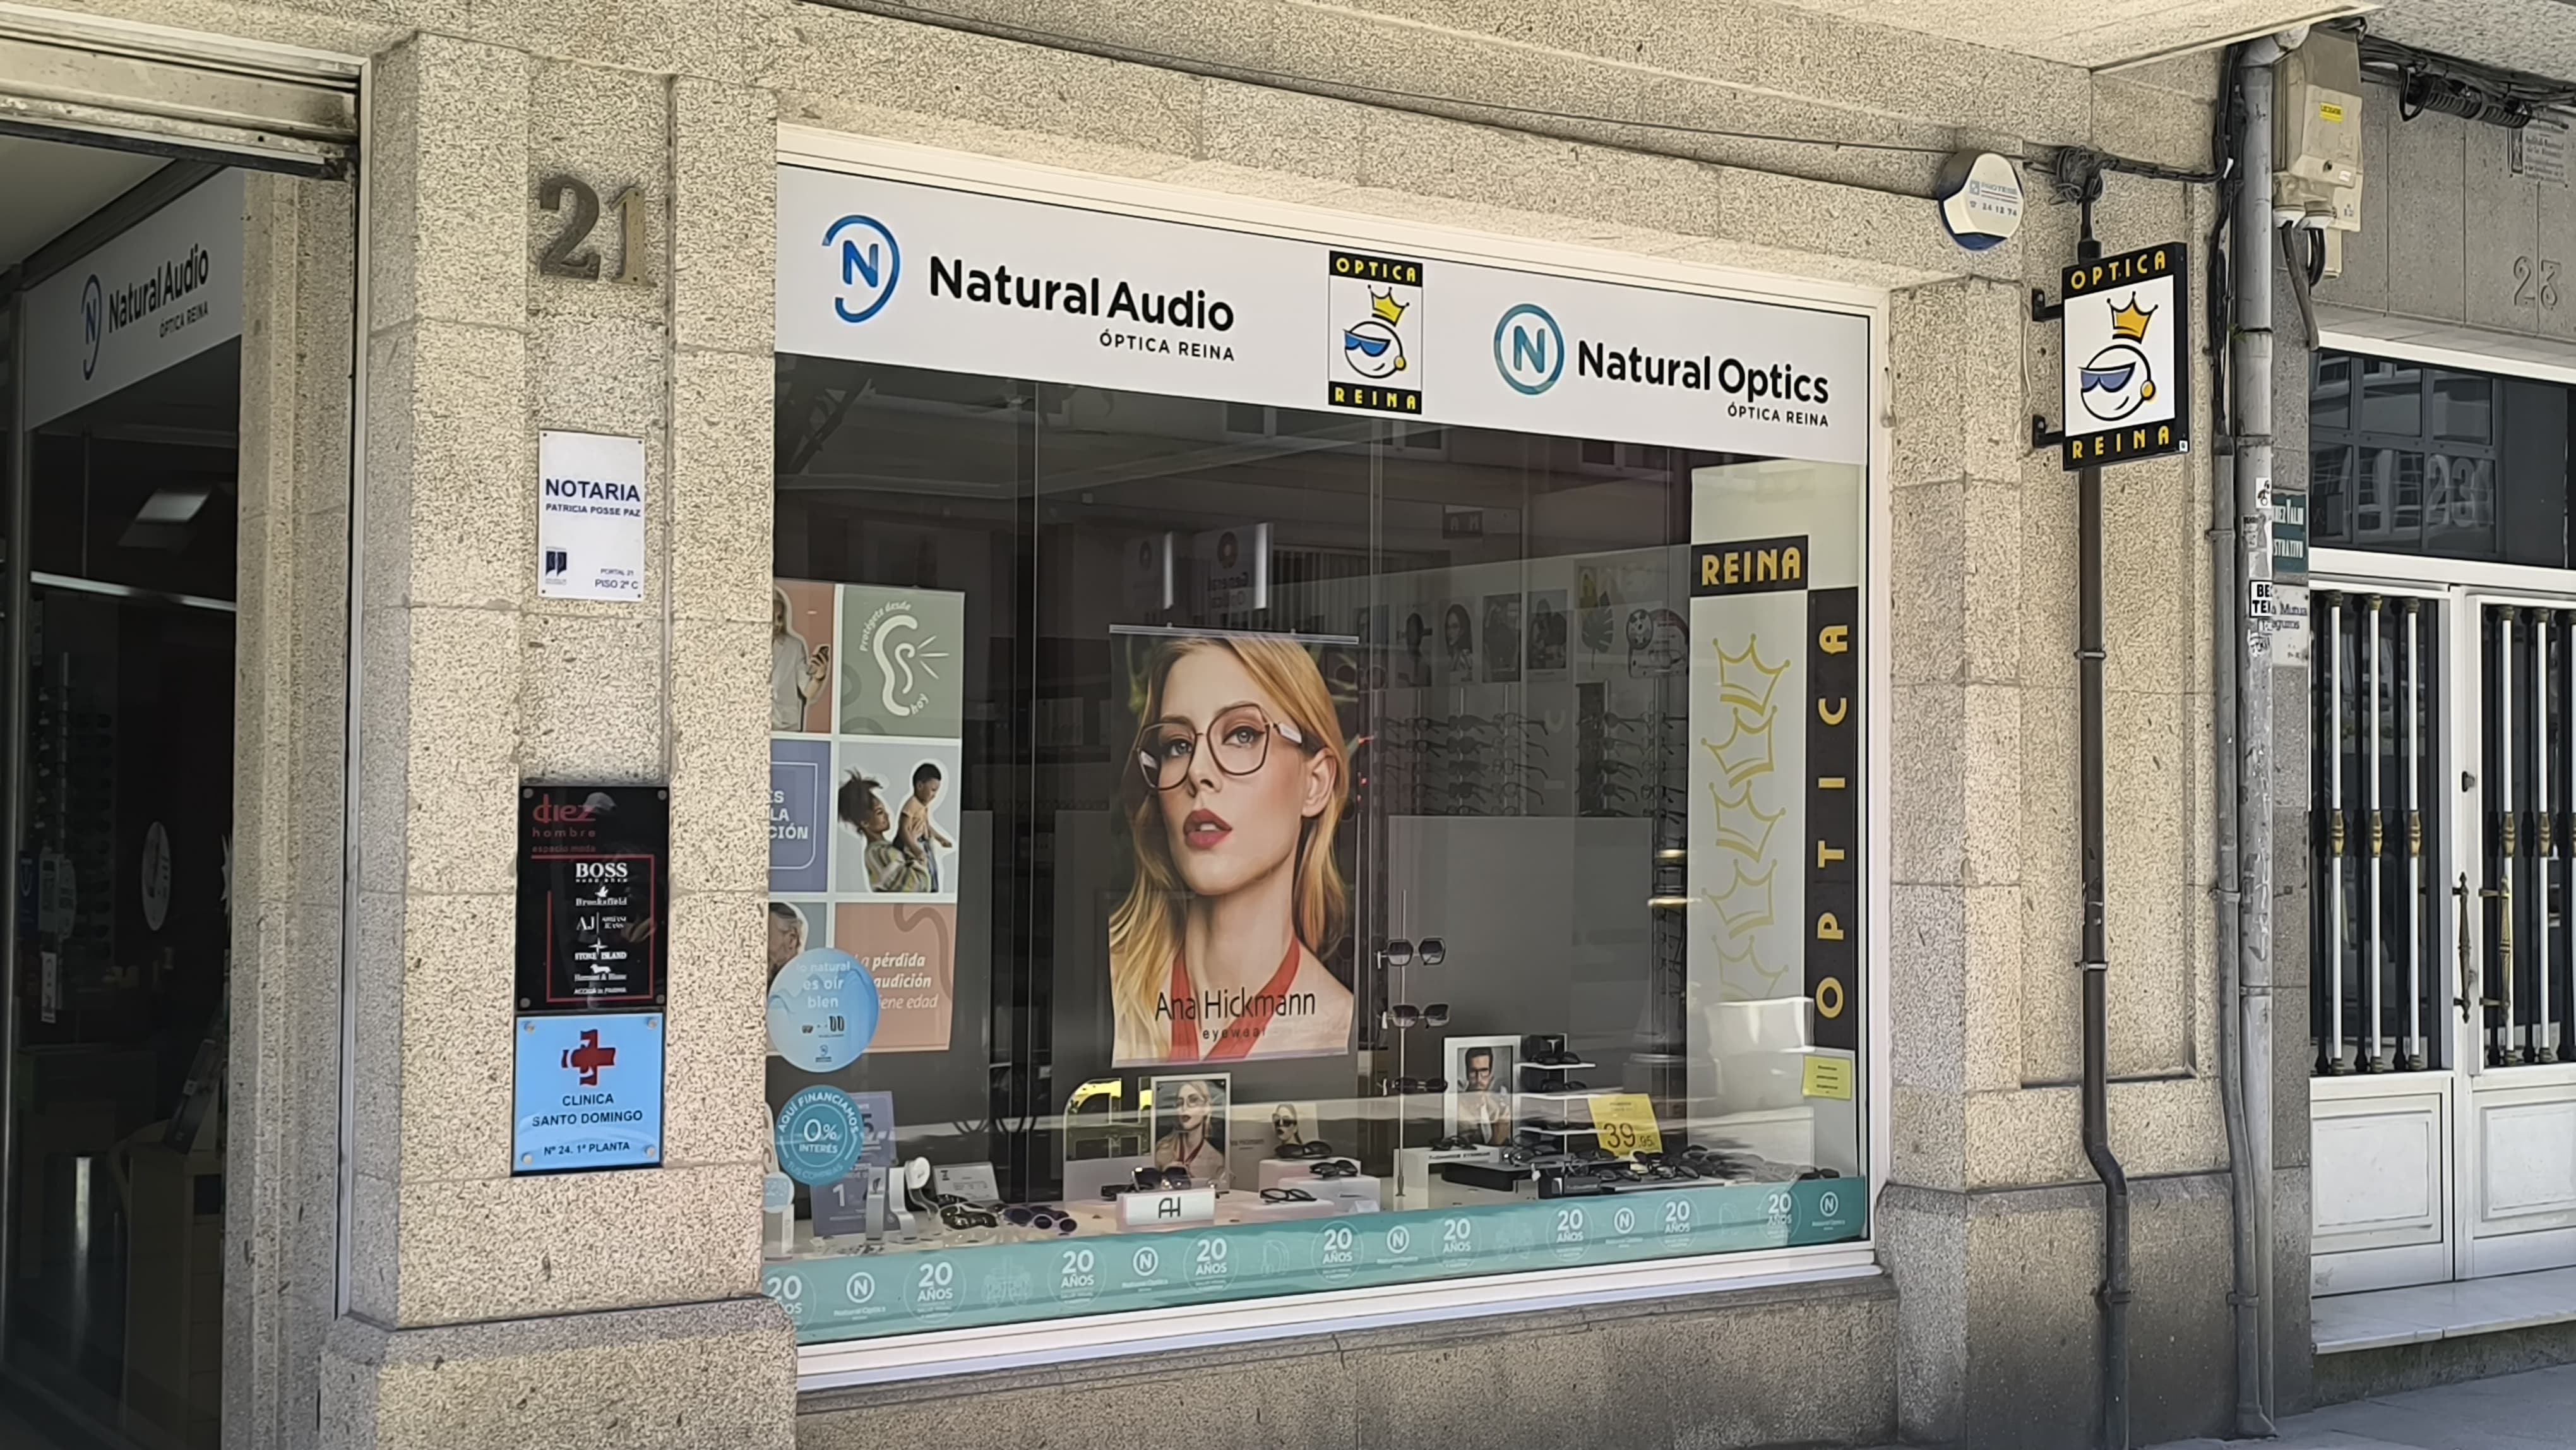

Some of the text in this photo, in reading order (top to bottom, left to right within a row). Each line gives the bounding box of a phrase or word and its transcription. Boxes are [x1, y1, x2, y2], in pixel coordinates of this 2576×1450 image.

[540, 176, 658, 287] 21
[1336, 257, 1416, 282] OPTICA
[2070, 250, 2167, 290] OPTICA
[187, 301, 209, 326] REINA
[1100, 329, 1235, 362] ÓPTICA REINA
[1335, 386, 1416, 410] REINA
[1727, 400, 1829, 428] ÓPTICA REINA
[2072, 426, 2170, 460] REINA
[545, 478, 641, 503] NOTARIA
[546, 503, 641, 517] PATRICIA POSSE PAZ
[1701, 546, 1801, 587] REINA
[595, 578, 618, 589] PISO
[631, 581, 639, 590] C
[910, 692, 929, 715] hoy
[532, 793, 597, 824] diez
[1816, 624, 1848, 1019] OPTICA
[532, 827, 596, 839] hombre
[575, 863, 628, 878] BOSS
[810, 961, 851, 973] natural
[872, 952, 926, 971] pérdida
[802, 980, 819, 991] es
[873, 973, 932, 988] audición
[808, 996, 839, 1009] bien
[907, 993, 939, 1009] edad
[1155, 986, 1316, 1021] Ana Hickmann
[1202, 1028, 1267, 1042] eyewear
[562, 1093, 614, 1107] CLINICA
[532, 1110, 643, 1127] SANTO DOMINGO
[777, 1091, 859, 1134] AQUÍ FINANCIAMOS
[588, 1141, 630, 1153] PLANTA
[798, 1142, 838, 1154] INTERÉS
[1665, 1200, 1691, 1223] 20
[1768, 1192, 1792, 1214] 20
[1444, 1218, 1471, 1241] 20
[1557, 1208, 1584, 1231] 20
[1664, 1220, 1691, 1234] AÑOS
[1324, 1227, 1353, 1251] 20
[1442, 1239, 1472, 1254] AÑOS
[1556, 1230, 1584, 1243] AÑOS
[1196, 1237, 1227, 1262] 20
[1323, 1248, 1353, 1265] AÑOS
[1061, 1249, 1095, 1275] 20
[1195, 1258, 1227, 1277] AÑOS
[919, 1261, 953, 1287] 20
[1060, 1272, 1095, 1290] AÑOS
[766, 1274, 802, 1301] 20
[917, 1284, 953, 1303] AÑOS
